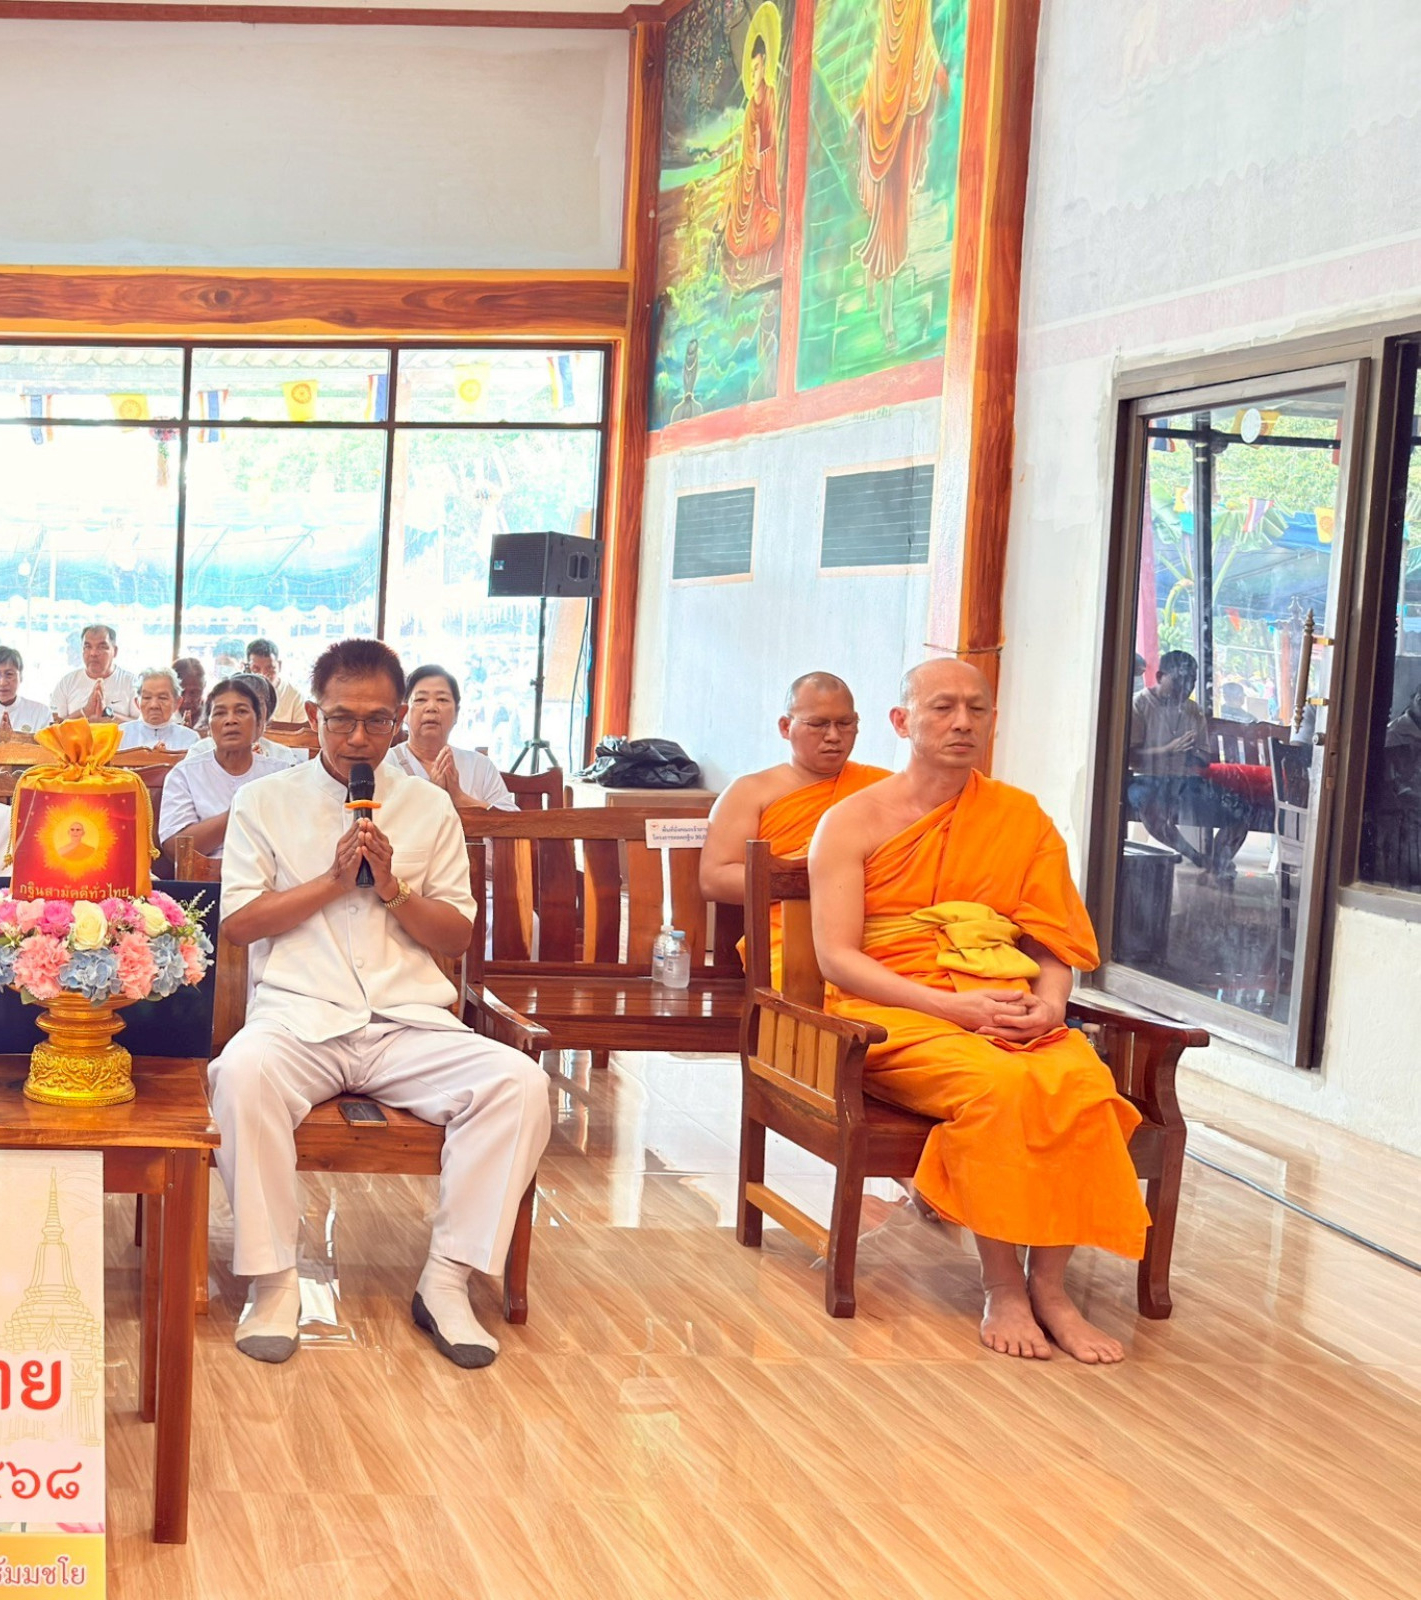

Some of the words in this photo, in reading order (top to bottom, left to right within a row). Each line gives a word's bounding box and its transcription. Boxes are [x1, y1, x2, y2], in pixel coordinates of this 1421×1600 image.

[19, 881, 130, 899] กฐินสามัคคีทั่วไทย
